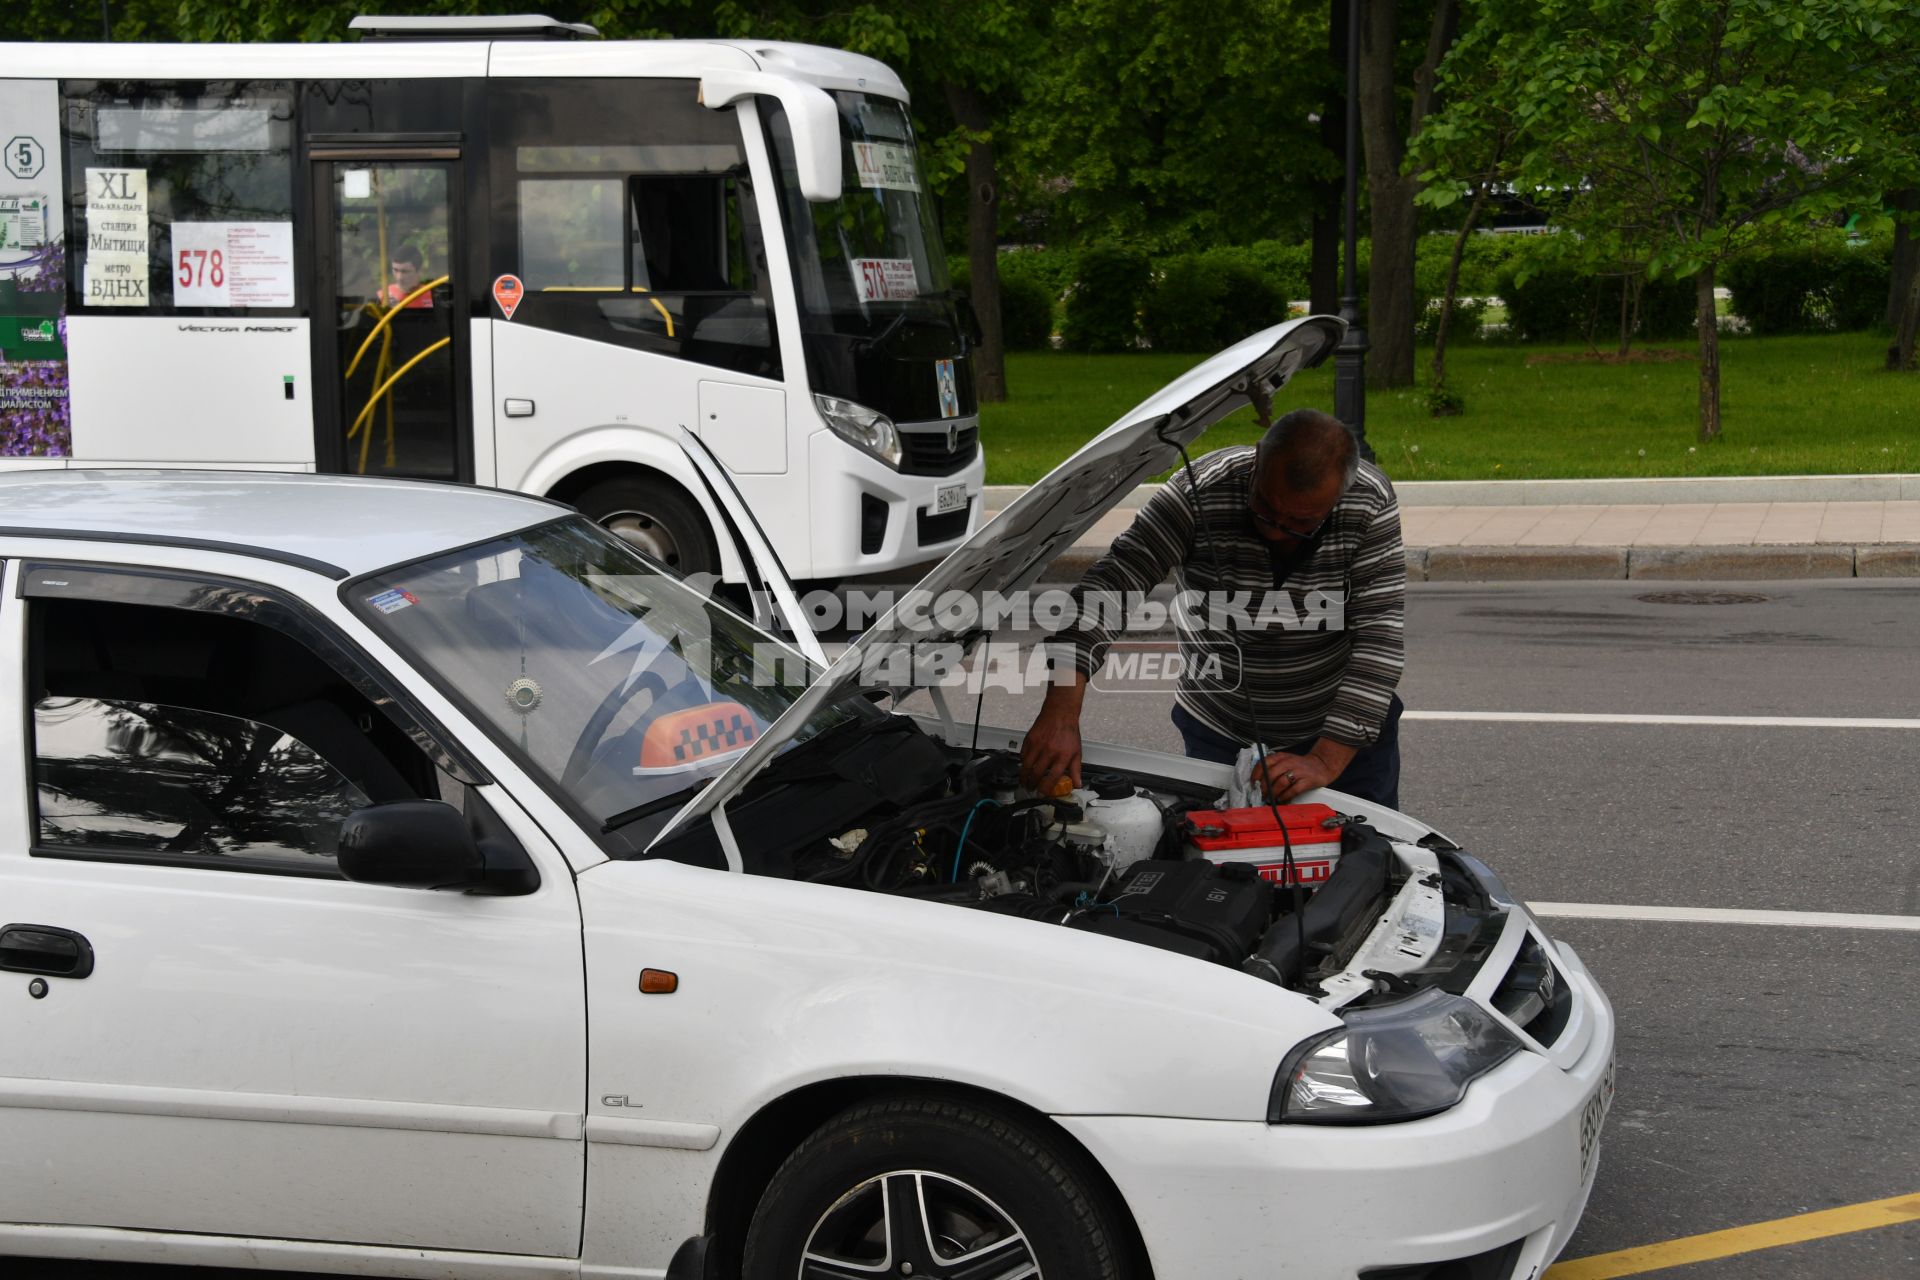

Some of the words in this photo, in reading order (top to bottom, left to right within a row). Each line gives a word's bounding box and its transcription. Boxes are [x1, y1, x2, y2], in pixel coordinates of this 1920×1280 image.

[19, 143, 32, 166] 5
[98, 172, 137, 200] XL
[100, 222, 138, 232] станция
[90, 234, 146, 254] Мытищи
[104, 264, 131, 277] метро
[179, 249, 224, 288] 578
[91, 279, 145, 300] ВДНХ
[862, 261, 889, 298] 578
[178, 325, 240, 333] VECTOR
[244, 325, 299, 333] NEXT
[5, 388, 68, 398] ПРИМЕНЕНИЕМ
[601, 1094, 644, 1107] GL
